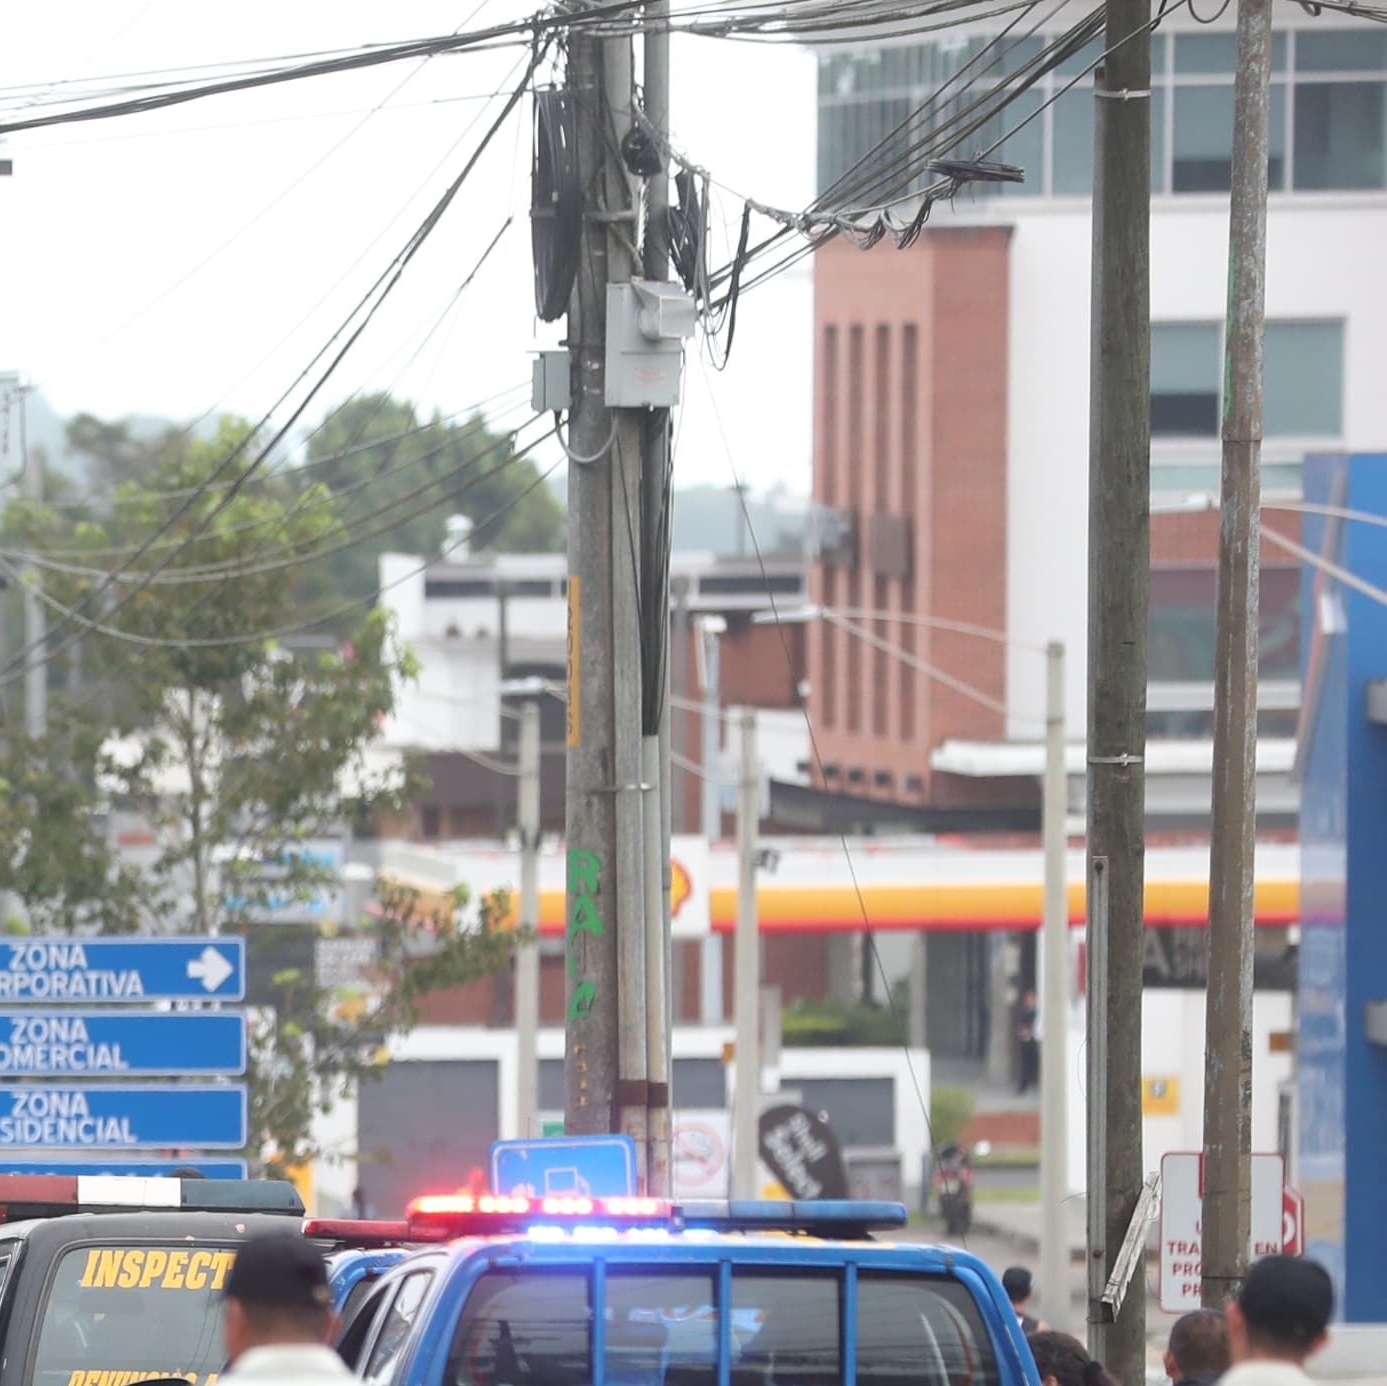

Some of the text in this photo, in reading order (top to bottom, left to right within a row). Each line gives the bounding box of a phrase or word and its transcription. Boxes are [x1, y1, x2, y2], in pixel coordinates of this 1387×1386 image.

[8, 943, 88, 970] ZONA
[9, 1018, 90, 1044] ZONA
[10, 1093, 90, 1119] ZONA
[1254, 1241, 1278, 1255] EN
[80, 1250, 237, 1290] INSPECT
